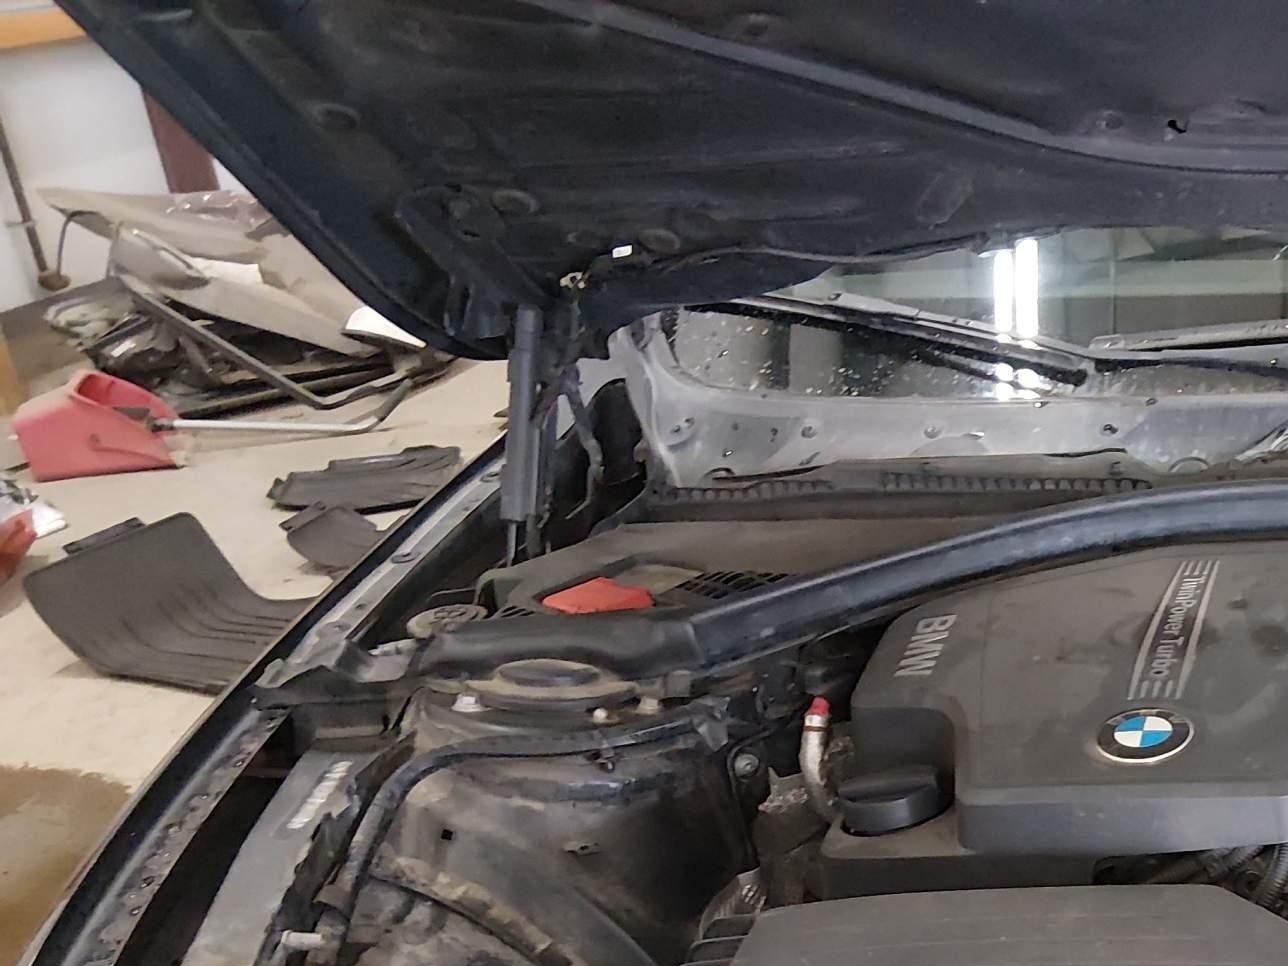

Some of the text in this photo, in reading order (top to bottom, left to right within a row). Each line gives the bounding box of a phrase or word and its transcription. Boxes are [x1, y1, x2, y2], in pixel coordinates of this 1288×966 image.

[894, 614, 958, 677] BMW
[1149, 576, 1207, 678] TwinPower Turbo
